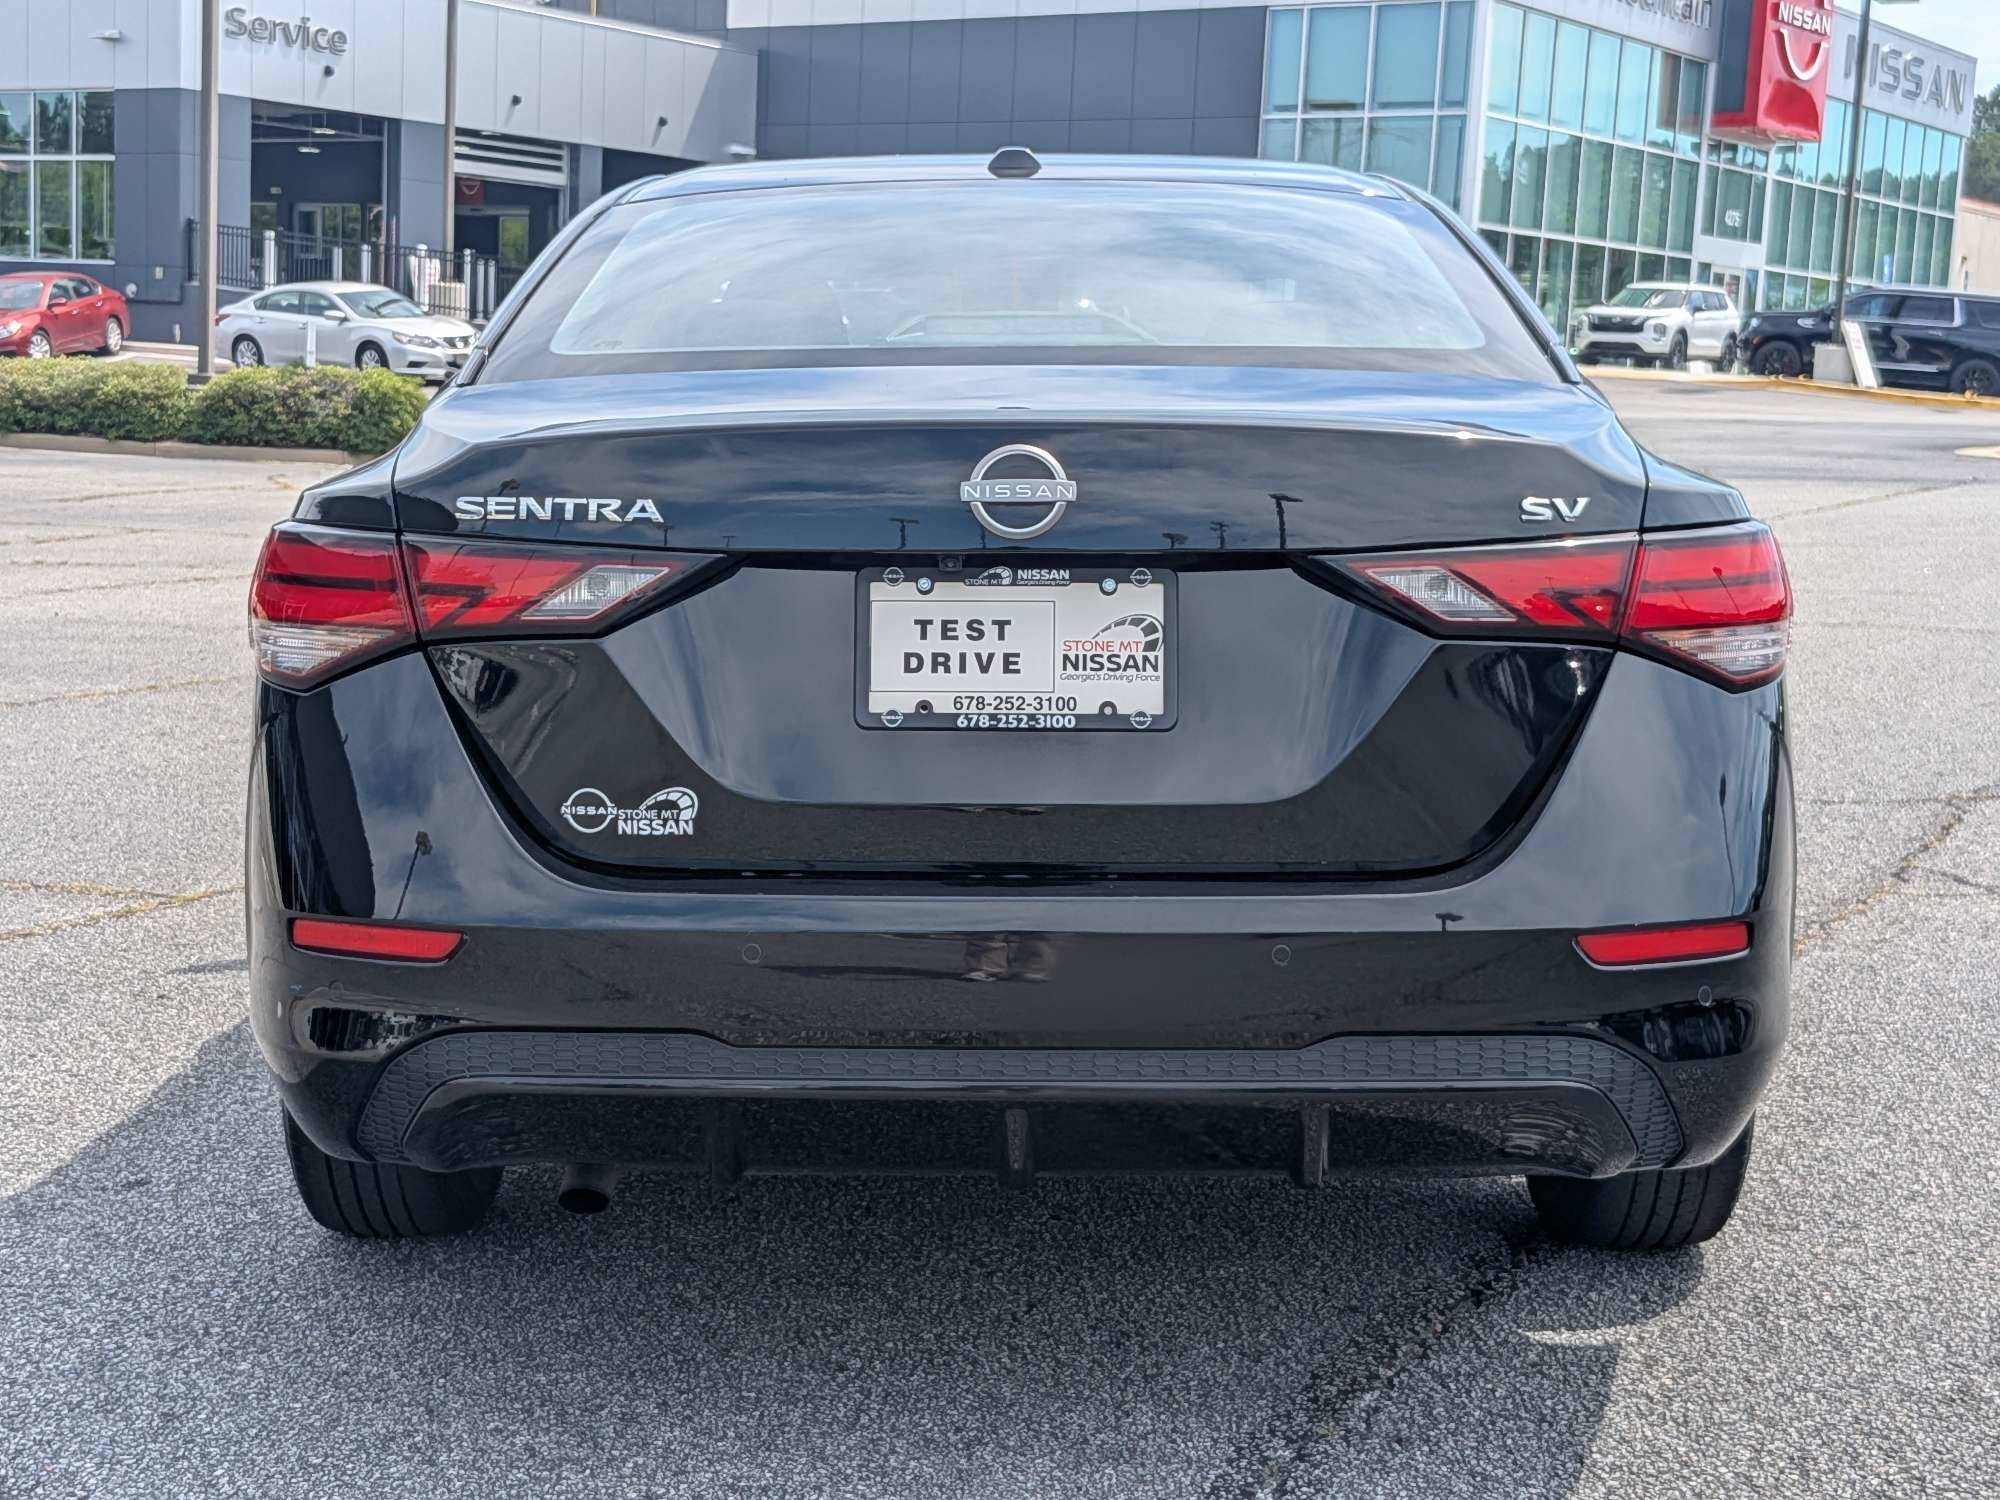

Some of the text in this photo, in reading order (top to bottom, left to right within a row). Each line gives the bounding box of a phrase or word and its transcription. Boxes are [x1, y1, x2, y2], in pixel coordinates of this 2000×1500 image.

[1778, 1, 1831, 36] NISSAN
[224, 8, 348, 56] Service
[964, 484, 1074, 499] NISSAN
[455, 496, 664, 523] SENTRA
[1521, 496, 1590, 522] SV
[1017, 569, 1070, 580] NISSAN
[913, 618, 1012, 641] TEST
[1063, 640, 1143, 653] STONE MT
[903, 652, 1021, 674] DRIVE
[1062, 653, 1159, 673] NISSAN
[1060, 672, 1161, 683] Georgia's Driving Force
[953, 695, 1078, 712] 678-252-3100
[956, 714, 1077, 729] 678-252-3100
[560, 805, 617, 816] NISSAN
[618, 809, 680, 820] STONE MT
[617, 820, 694, 836] NISSAN
